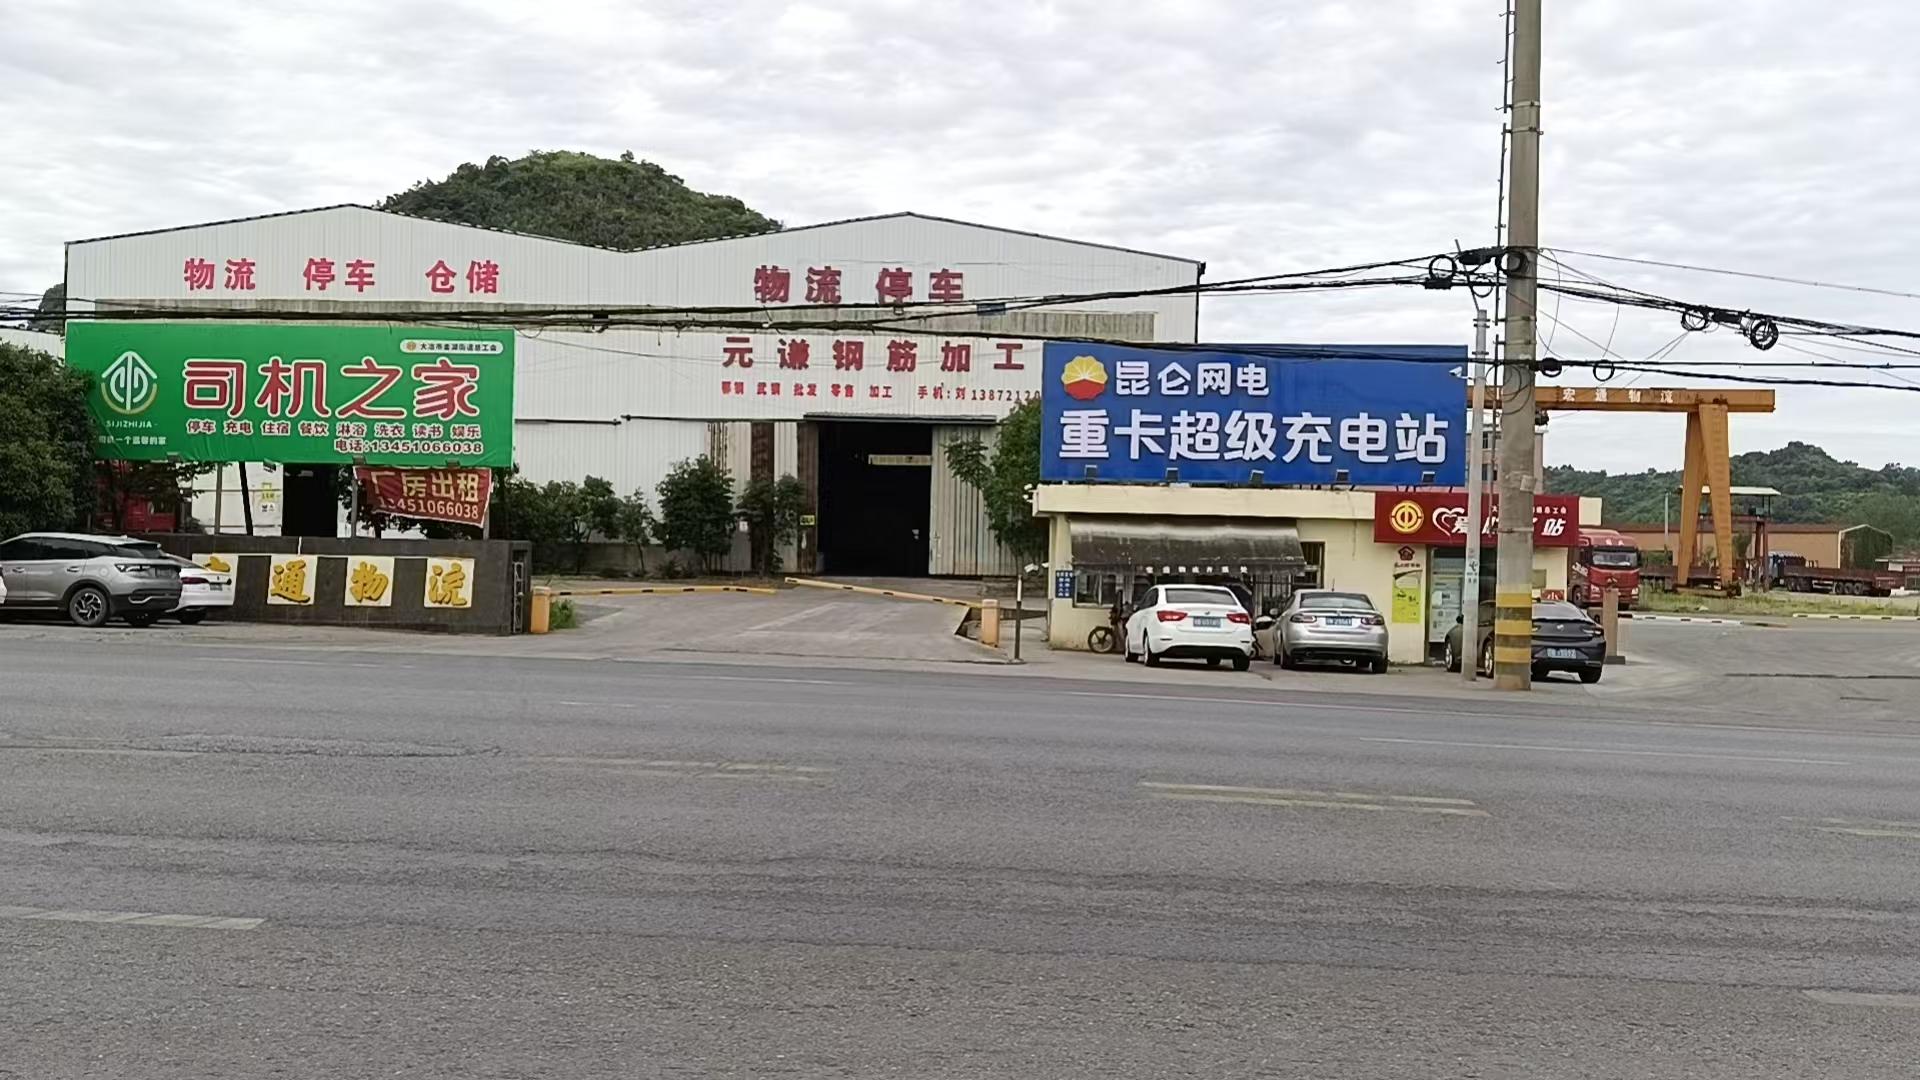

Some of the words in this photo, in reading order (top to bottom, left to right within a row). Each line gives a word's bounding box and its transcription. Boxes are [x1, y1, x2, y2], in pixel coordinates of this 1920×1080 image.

[184, 258, 257, 290] 物流
[303, 258, 374, 291] 停车
[426, 260, 499, 292] 仓储
[753, 265, 841, 304] 物流
[875, 267, 963, 306] 停车
[722, 336, 1024, 373] 元谦钢筋加工
[183, 356, 480, 420] 司机之家
[793, 384, 818, 396] 批发
[830, 384, 855, 397] 零售
[869, 386, 892, 398] 加工
[1115, 361, 1270, 396] 昆仑网电
[105, 420, 152, 428] SIJIZHIJIA
[187, 420, 216, 434] 停车
[224, 421, 253, 434] 充电
[262, 422, 291, 436] 住宿
[300, 423, 329, 437] 餐饮
[336, 424, 367, 437] 淋浴
[375, 425, 405, 438] 洗衣
[413, 425, 443, 438] 读书
[451, 426, 482, 440] 娱乐
[1059, 409, 1449, 464] 重卡超级充电站
[334, 438, 484, 454] 电话:13451066038
[370, 470, 479, 502] 厂房出租
